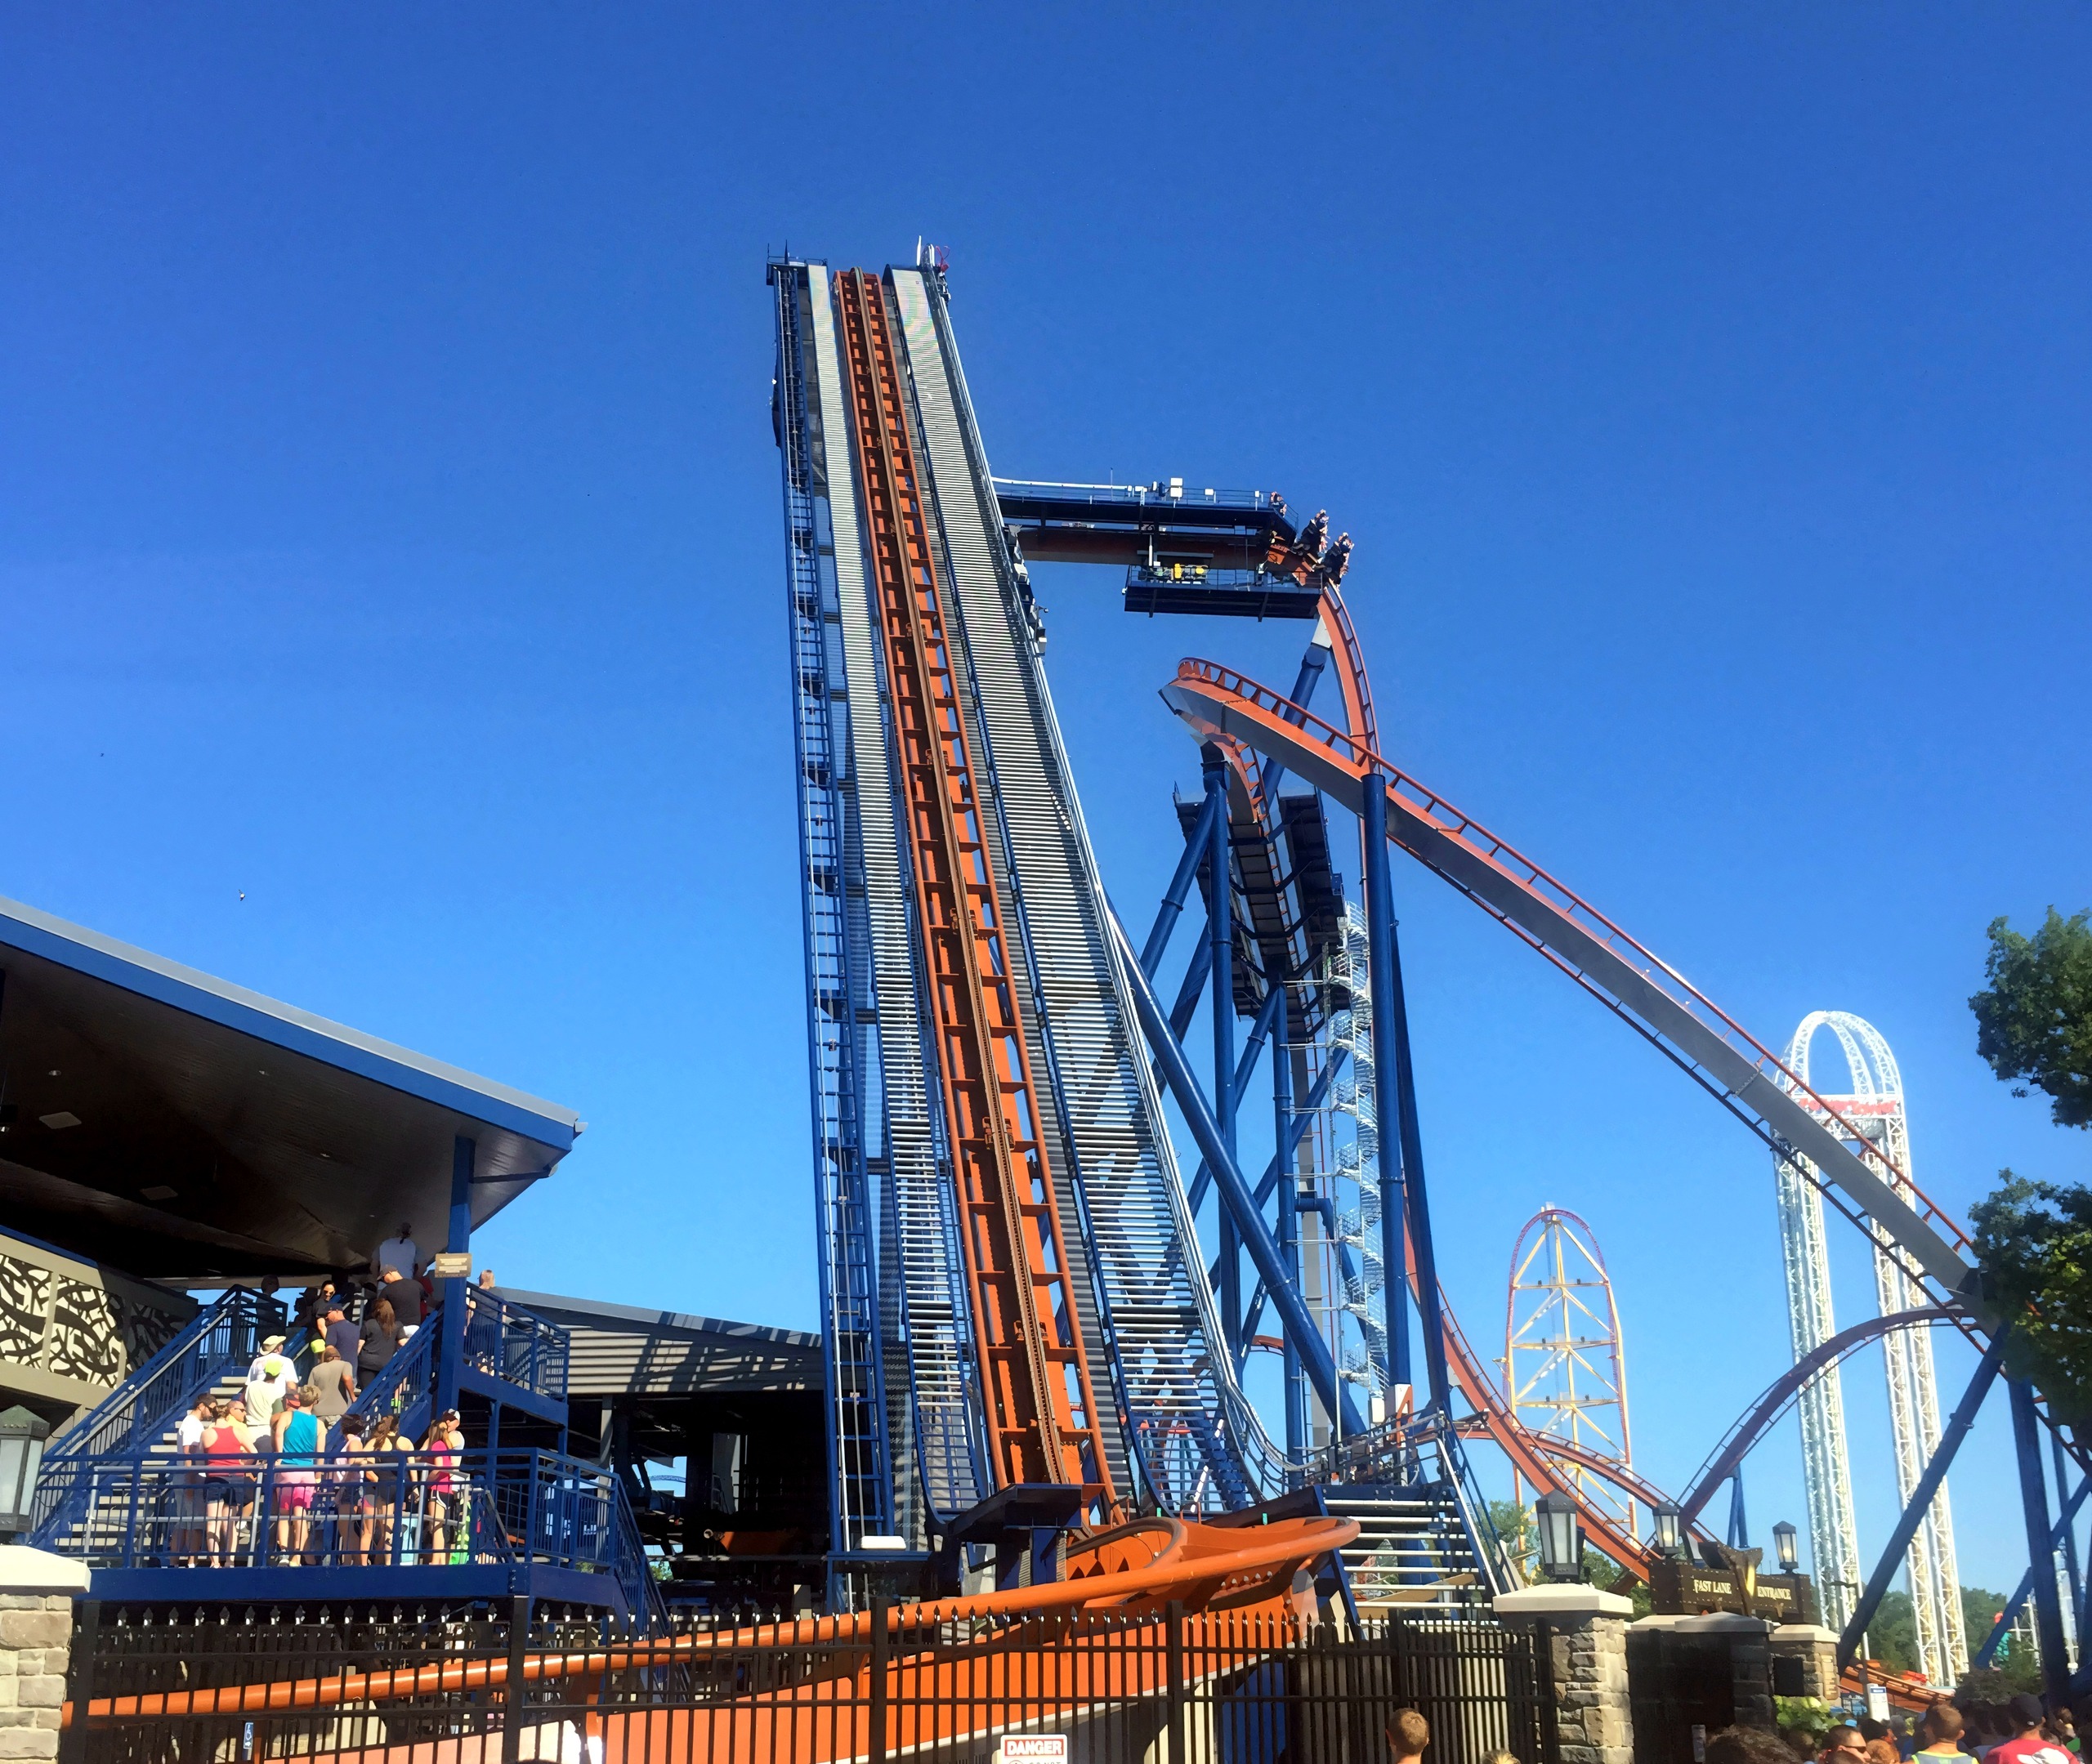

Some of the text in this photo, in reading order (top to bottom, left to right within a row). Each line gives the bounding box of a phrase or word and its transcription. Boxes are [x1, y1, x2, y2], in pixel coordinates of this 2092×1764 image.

[1693, 1579, 1791, 1600] FAST LANE ENTRANCE
[1007, 1739, 1062, 1756] DANGER
